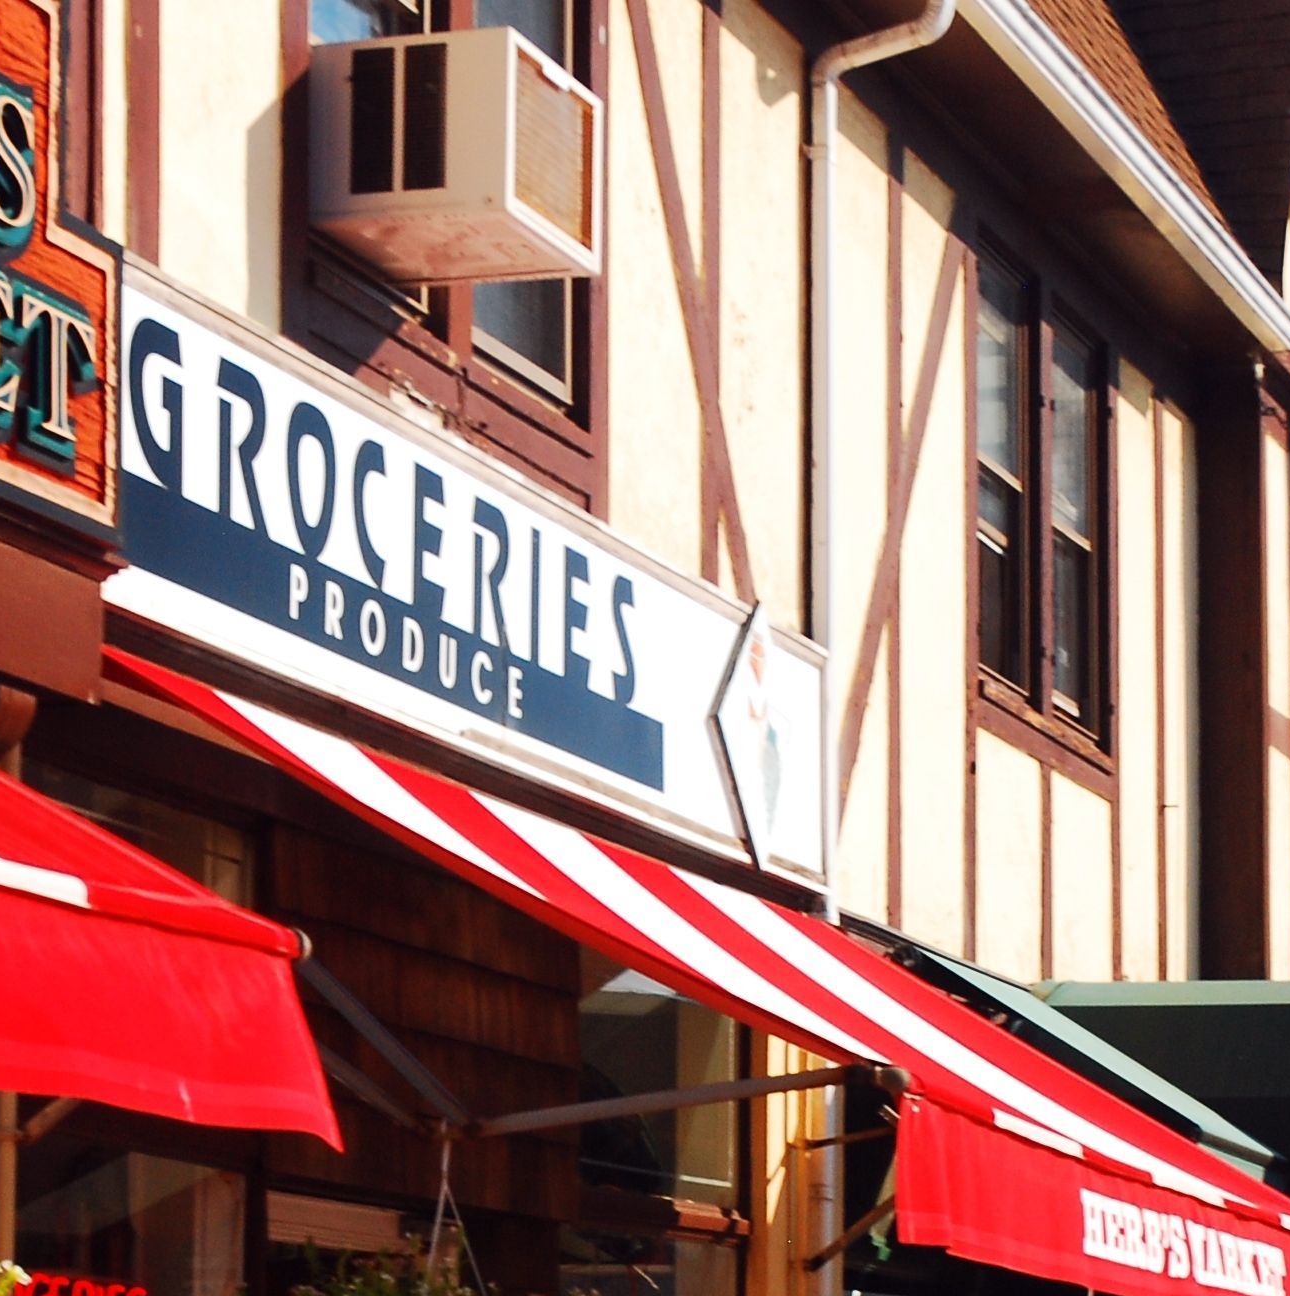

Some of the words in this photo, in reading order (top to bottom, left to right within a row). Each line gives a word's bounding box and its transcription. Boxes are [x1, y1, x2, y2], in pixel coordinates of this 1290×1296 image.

[129, 318, 636, 704] GROCERIES
[289, 564, 524, 720] PRODUCE
[1080, 1187, 1191, 1279] HERB'S
